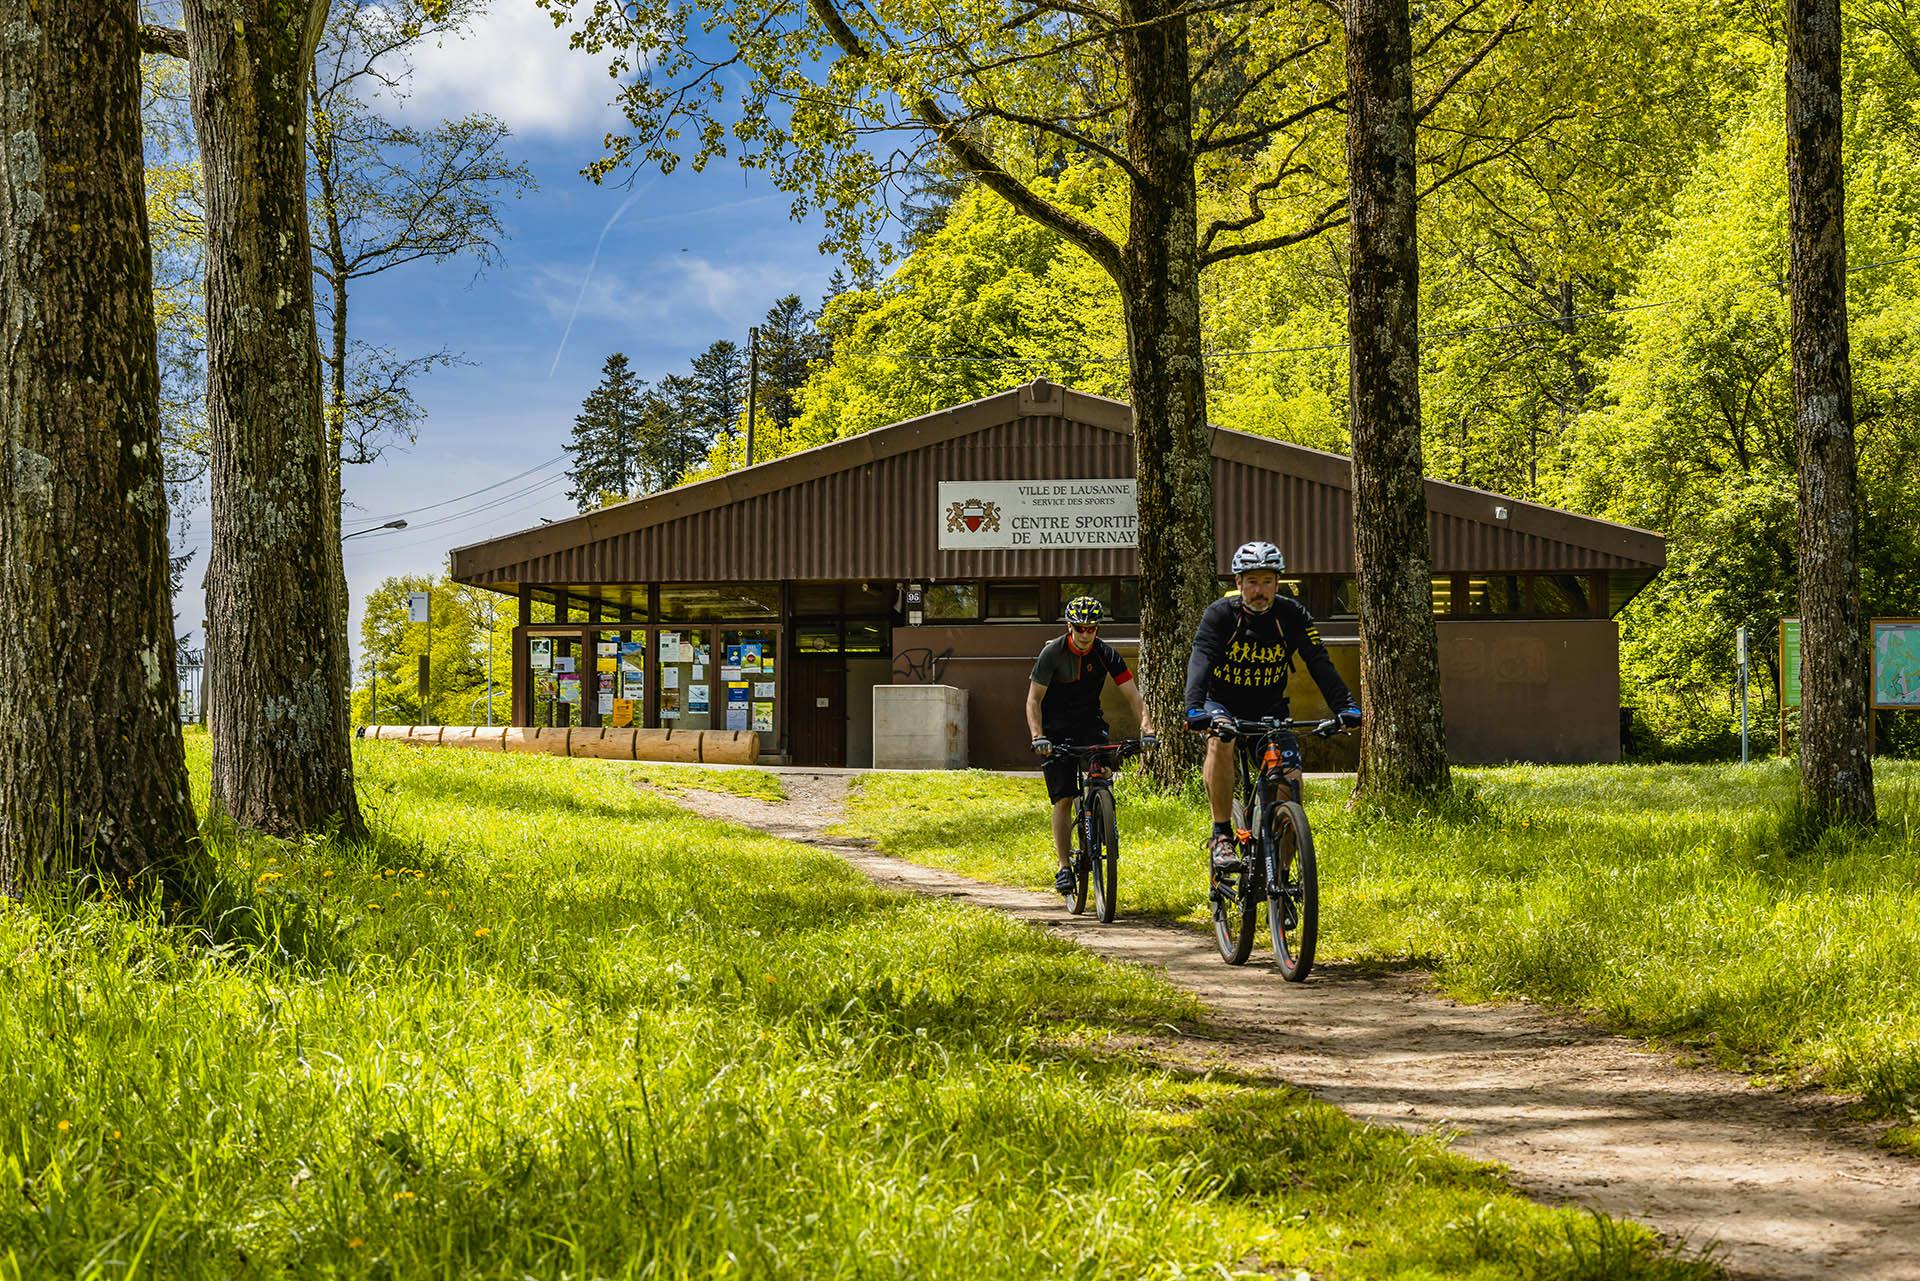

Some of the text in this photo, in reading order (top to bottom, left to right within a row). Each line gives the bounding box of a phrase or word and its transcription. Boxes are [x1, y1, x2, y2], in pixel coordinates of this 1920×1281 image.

[1018, 485, 1130, 495] VILLE DE LAUSANNE
[1032, 498, 1065, 506] SERVICE
[1067, 498, 1083, 506] DES
[1011, 516, 1136, 529] CENTRE SPORTIF
[1012, 531, 1136, 544] DE MAUVERNAY
[908, 593, 920, 601] 95
[1216, 661, 1288, 676] AUSANN
